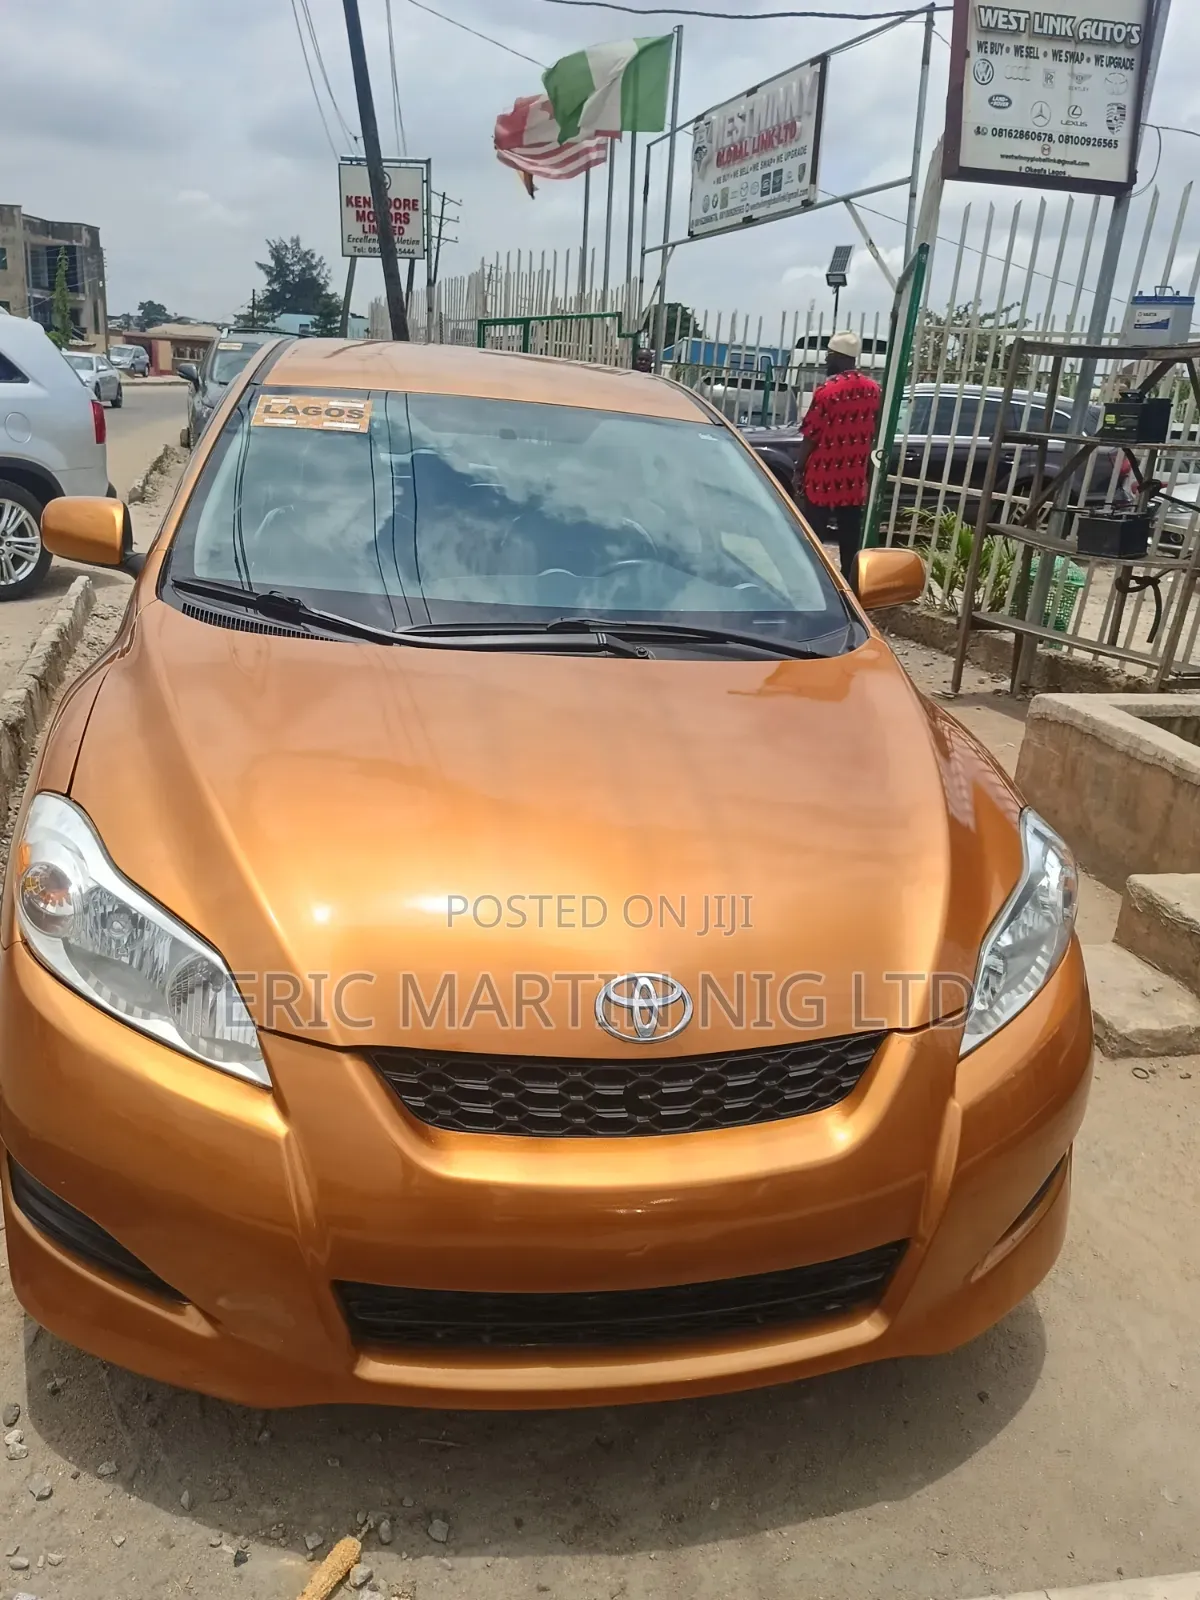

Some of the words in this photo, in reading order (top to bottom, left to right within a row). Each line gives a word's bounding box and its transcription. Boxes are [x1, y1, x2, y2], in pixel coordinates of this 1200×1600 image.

[978, 5, 1030, 32] WEST
[1032, 12, 1076, 38] LINK
[1077, 18, 1142, 46] AUTO'S
[976, 40, 988, 54] WE
[990, 41, 1005, 56] BUY
[1013, 44, 1025, 58] WE
[1025, 45, 1040, 60] SELL
[1051, 48, 1064, 63] WE
[1064, 50, 1085, 65] SWAP
[1094, 54, 1105, 68] WE
[1105, 55, 1135, 71] UPGRADE
[1060, 119, 1088, 127] LEXUS
[991, 127, 1055, 144] 08162860678,
[1058, 134, 1119, 149] 08100926565
[716, 140, 749, 169] GLOBAL
[752, 129, 776, 155] LINK
[752, 162, 760, 172] WE
[760, 157, 774, 170] SWAP
[776, 154, 784, 164] WE
[784, 145, 808, 162] UPGRADE
[1048, 168, 1066, 177] Lagos
[346, 195, 420, 211] KENORE
[356, 210, 411, 225] MORS
[263, 404, 364, 419] LAGOS
